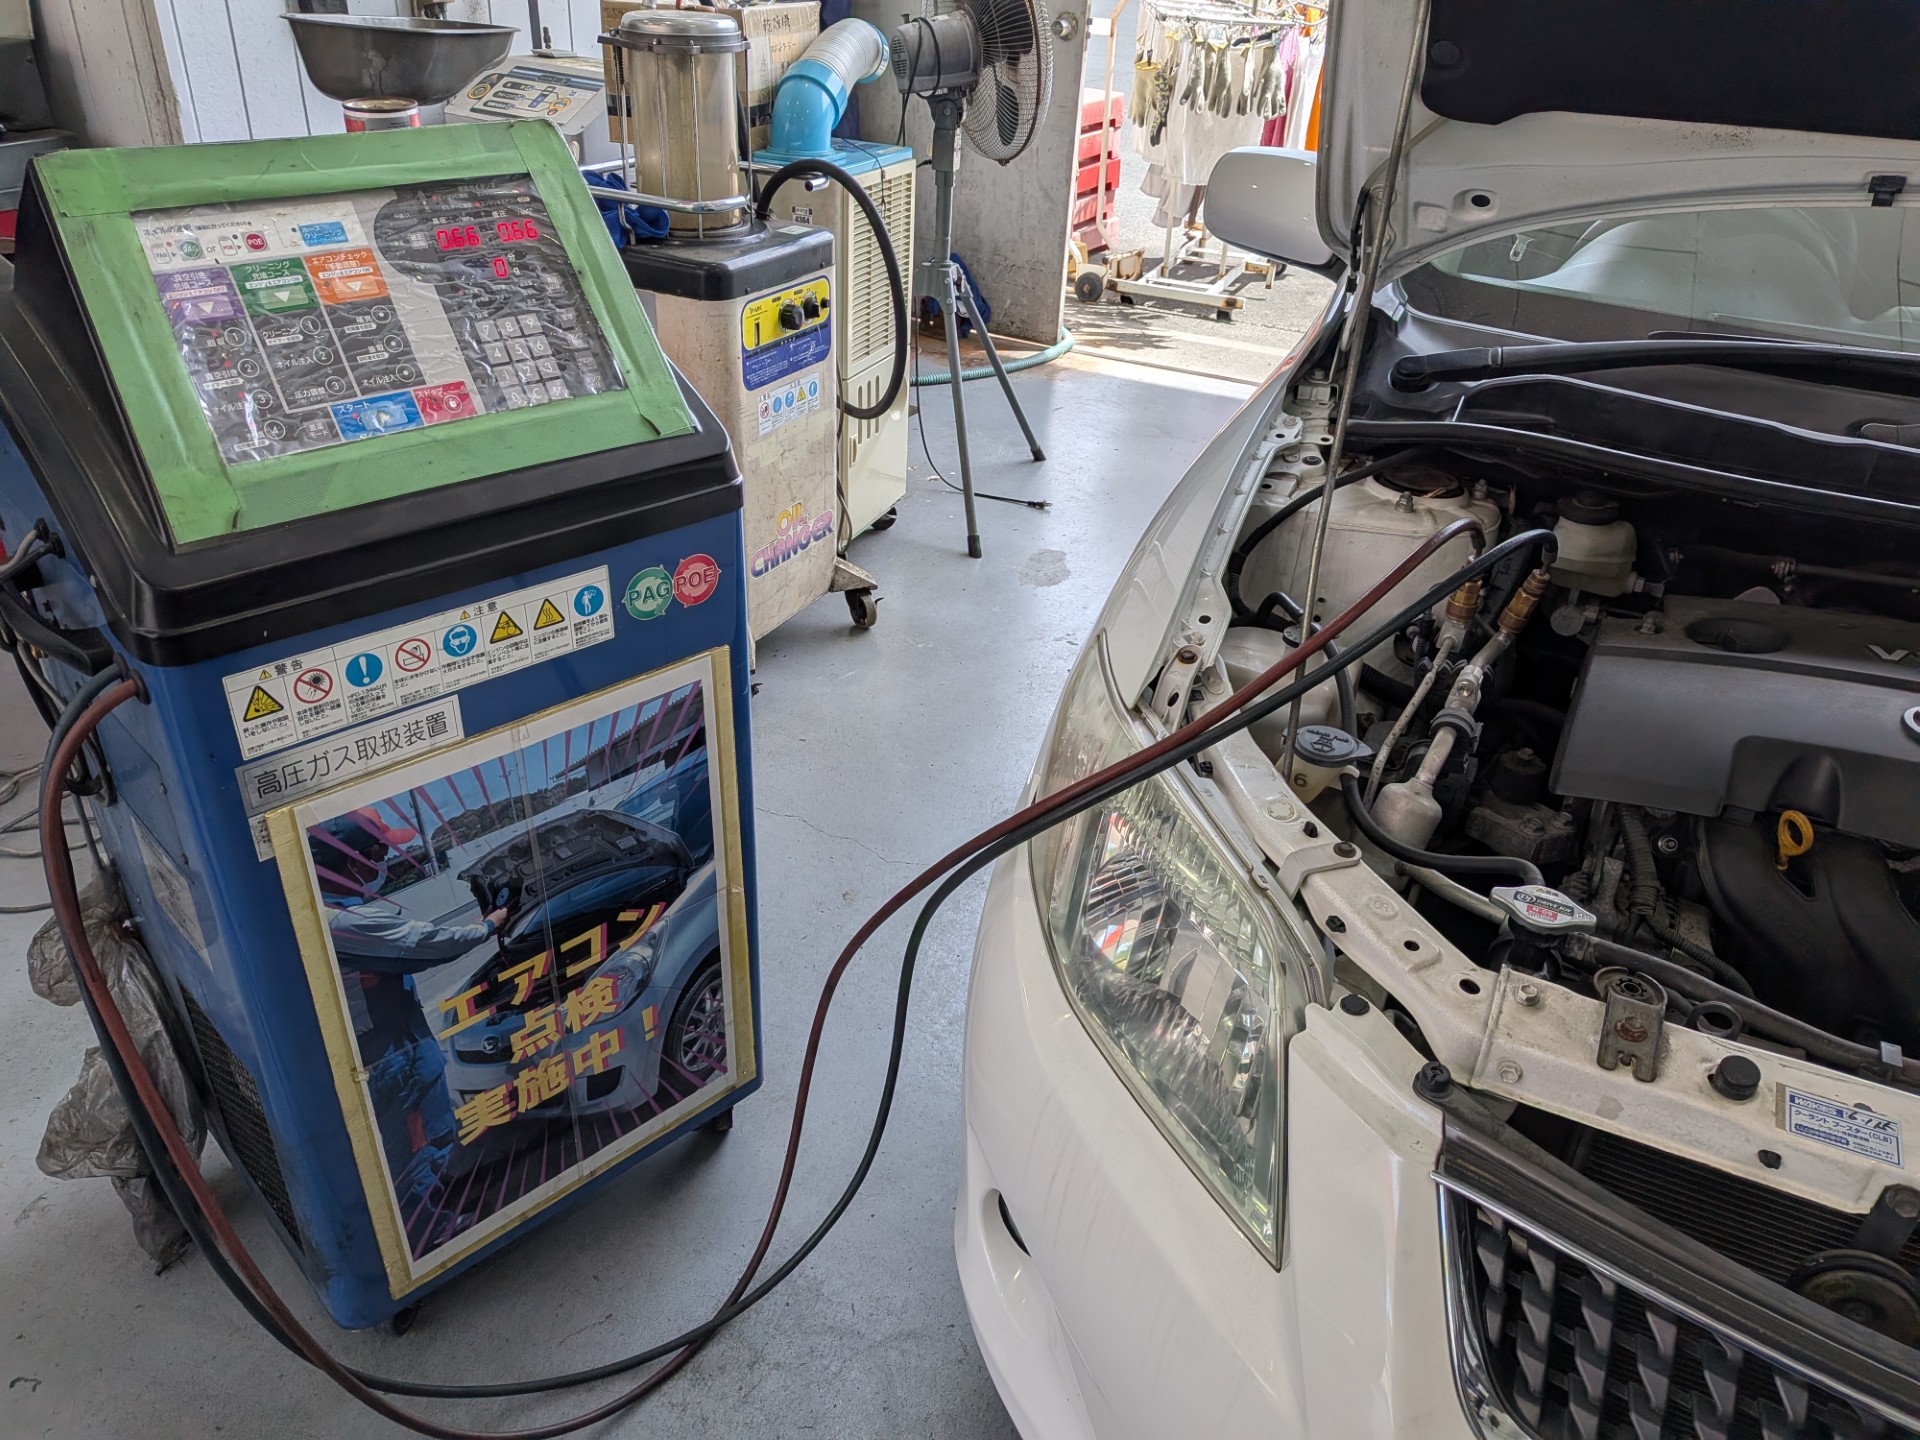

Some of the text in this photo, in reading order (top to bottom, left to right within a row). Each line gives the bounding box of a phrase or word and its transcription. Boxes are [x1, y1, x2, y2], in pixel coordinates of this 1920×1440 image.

[247, 237, 264, 247] POE
[304, 229, 342, 239] クリーニング
[312, 252, 367, 264] エアコンチェック
[246, 261, 290, 273] クリーニング
[492, 257, 509, 278] 0
[262, 327, 300, 338] クリーニング
[482, 318, 534, 336] 7 8 9
[494, 340, 544, 358] 4 5 6
[275, 357, 315, 368] オイル注入
[502, 361, 553, 380] 1 2 3
[362, 374, 399, 387] オイル注入
[337, 401, 370, 413] スタート
[776, 502, 807, 537] OIL
[751, 510, 833, 577] CHANGER
[628, 566, 715, 607] PAG POE
[473, 601, 498, 616] 注意
[274, 659, 303, 676] 警告
[253, 710, 449, 799] 高圧ガス取扱装置
[1294, 773, 1308, 788] 6
[1537, 899, 1559, 908] DRIVE
[438, 903, 664, 1041] エアコン
[510, 975, 621, 1064] 点検
[1794, 1109, 1829, 1124] クーラント
[1832, 1119, 1893, 1144] ブースター(CLB)
